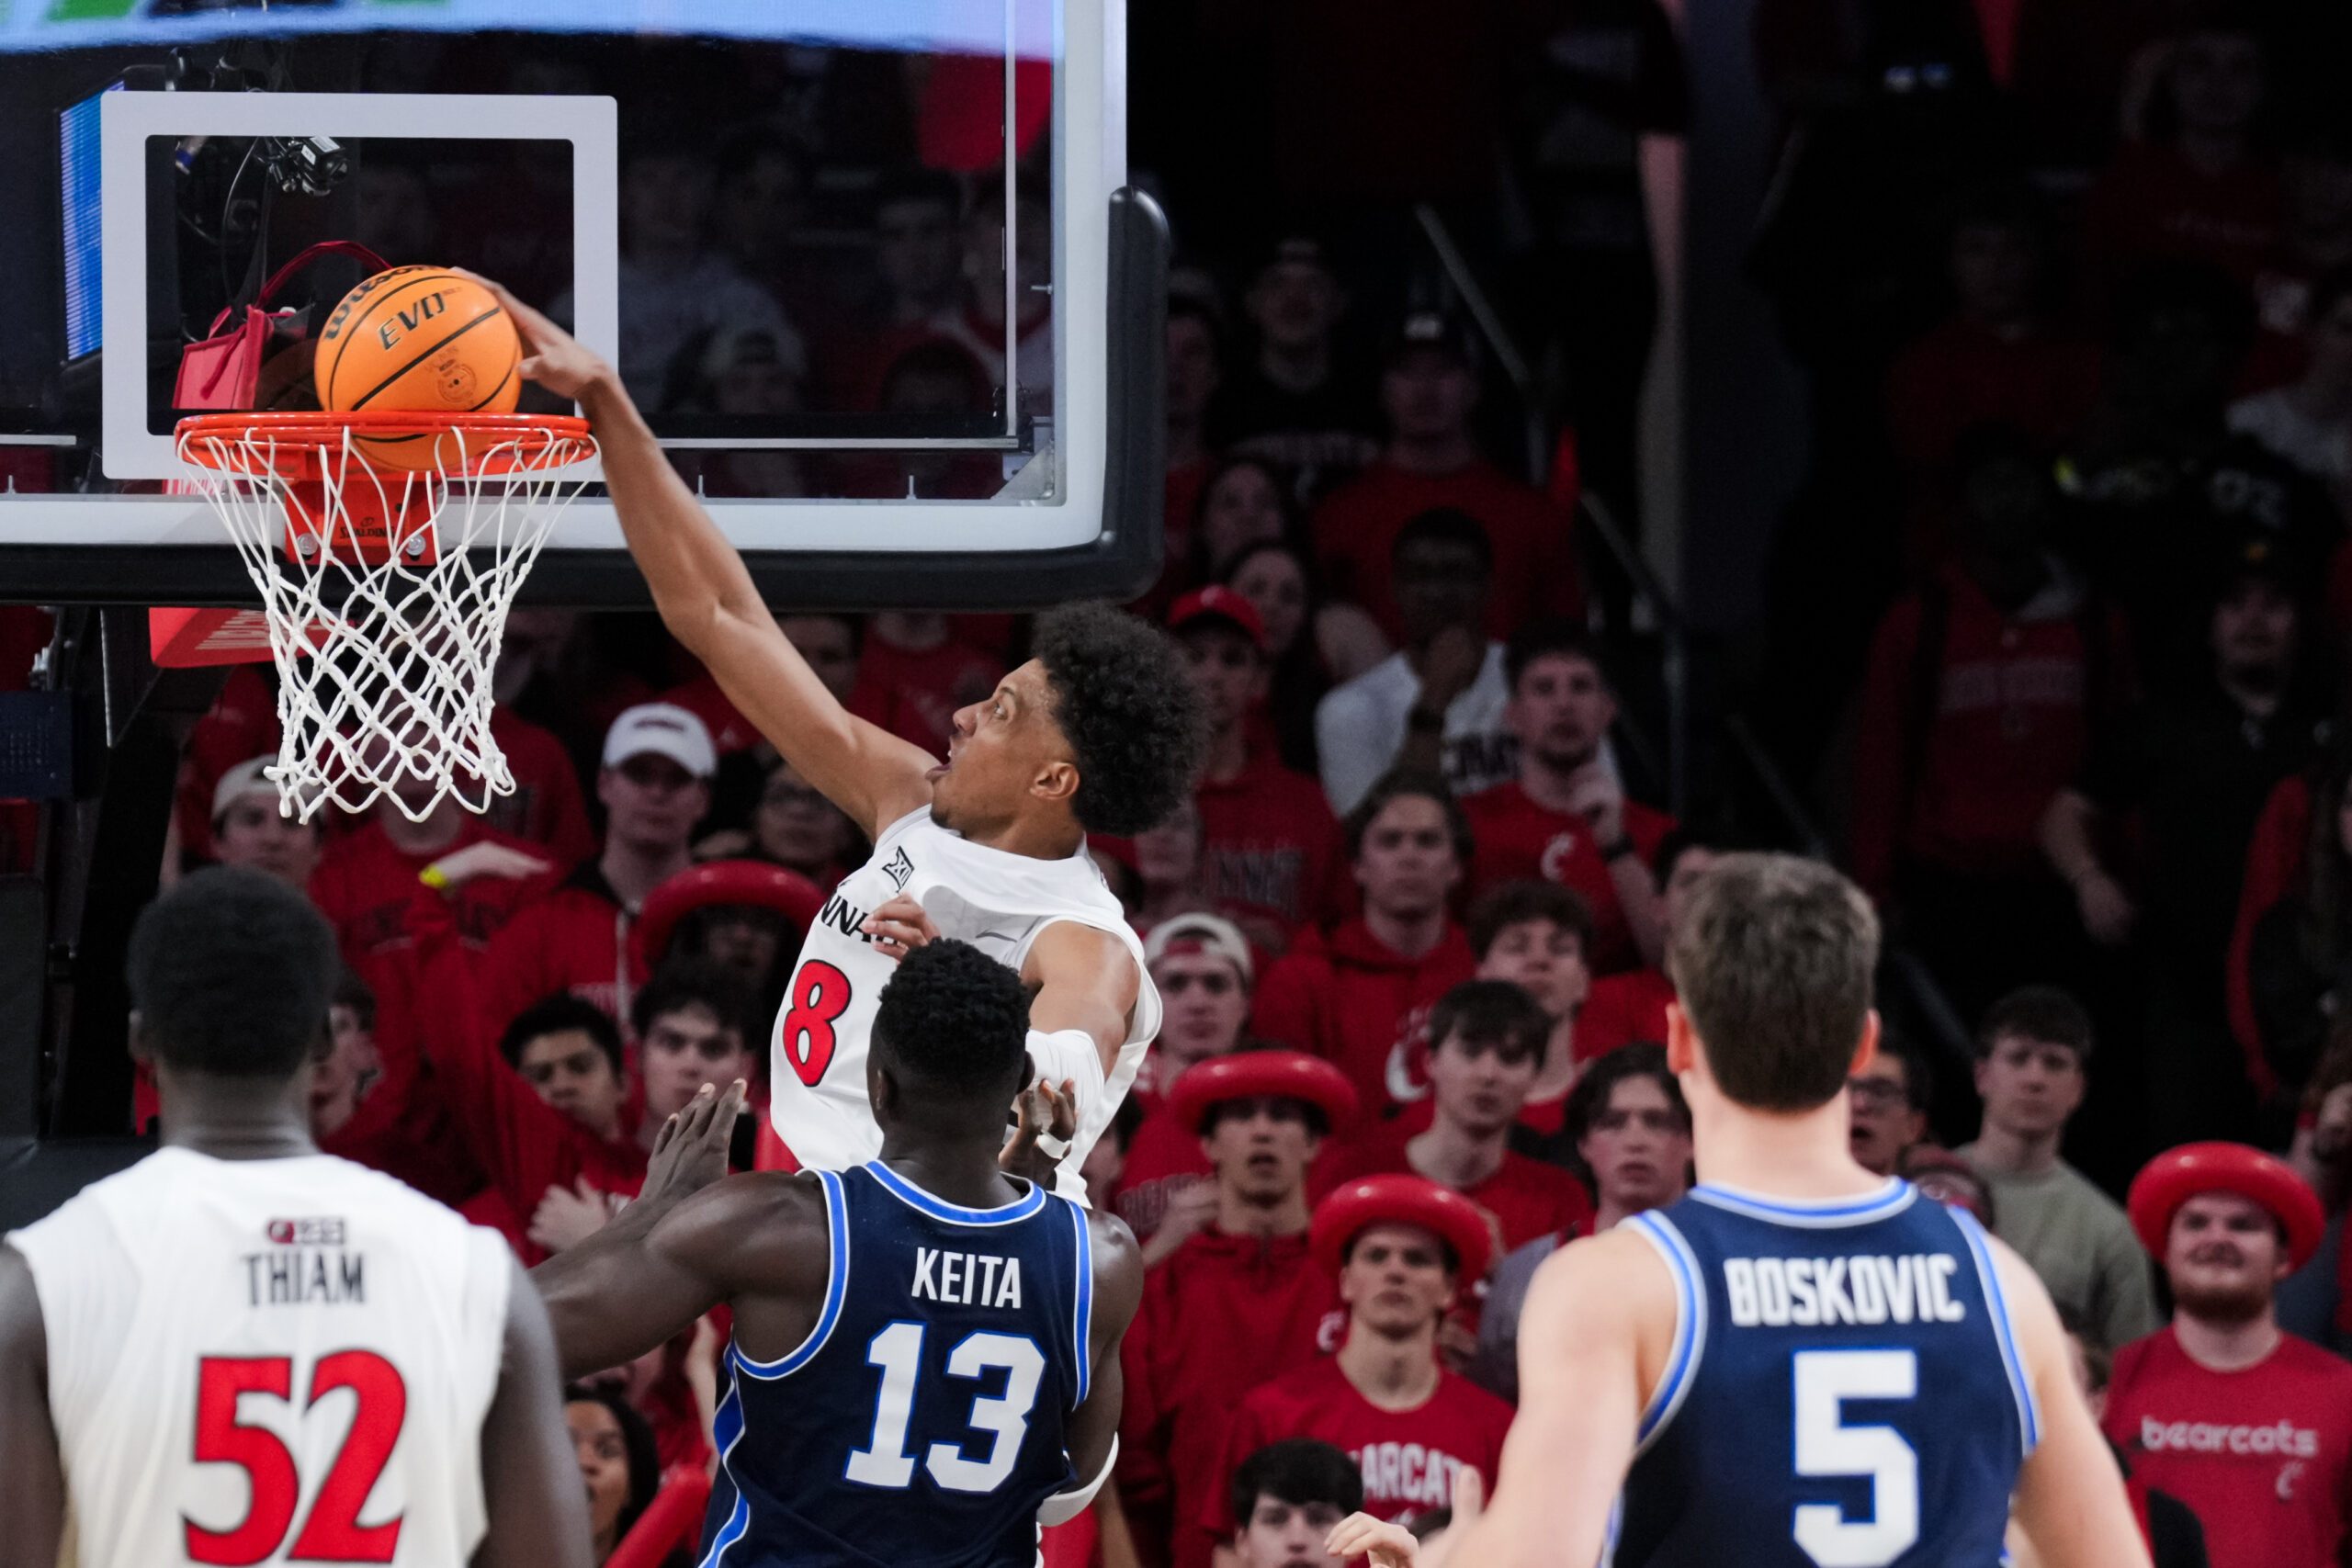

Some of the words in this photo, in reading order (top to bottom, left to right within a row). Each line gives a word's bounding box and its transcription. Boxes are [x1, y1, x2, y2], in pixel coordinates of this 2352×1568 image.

[378, 291, 447, 351] EVO
[783, 958, 851, 1088] 8
[243, 1251, 366, 1307] THIAM
[911, 1246, 1023, 1310] KEITA
[1723, 1252, 1966, 1327] BOSKOVIC
[842, 1317, 1048, 1494] 13
[2140, 1414, 2320, 1459] bearcats
[182, 1349, 407, 1566] 52
[1347, 1439, 1464, 1508] ARCAT
[1791, 1346, 1920, 1568] 5
